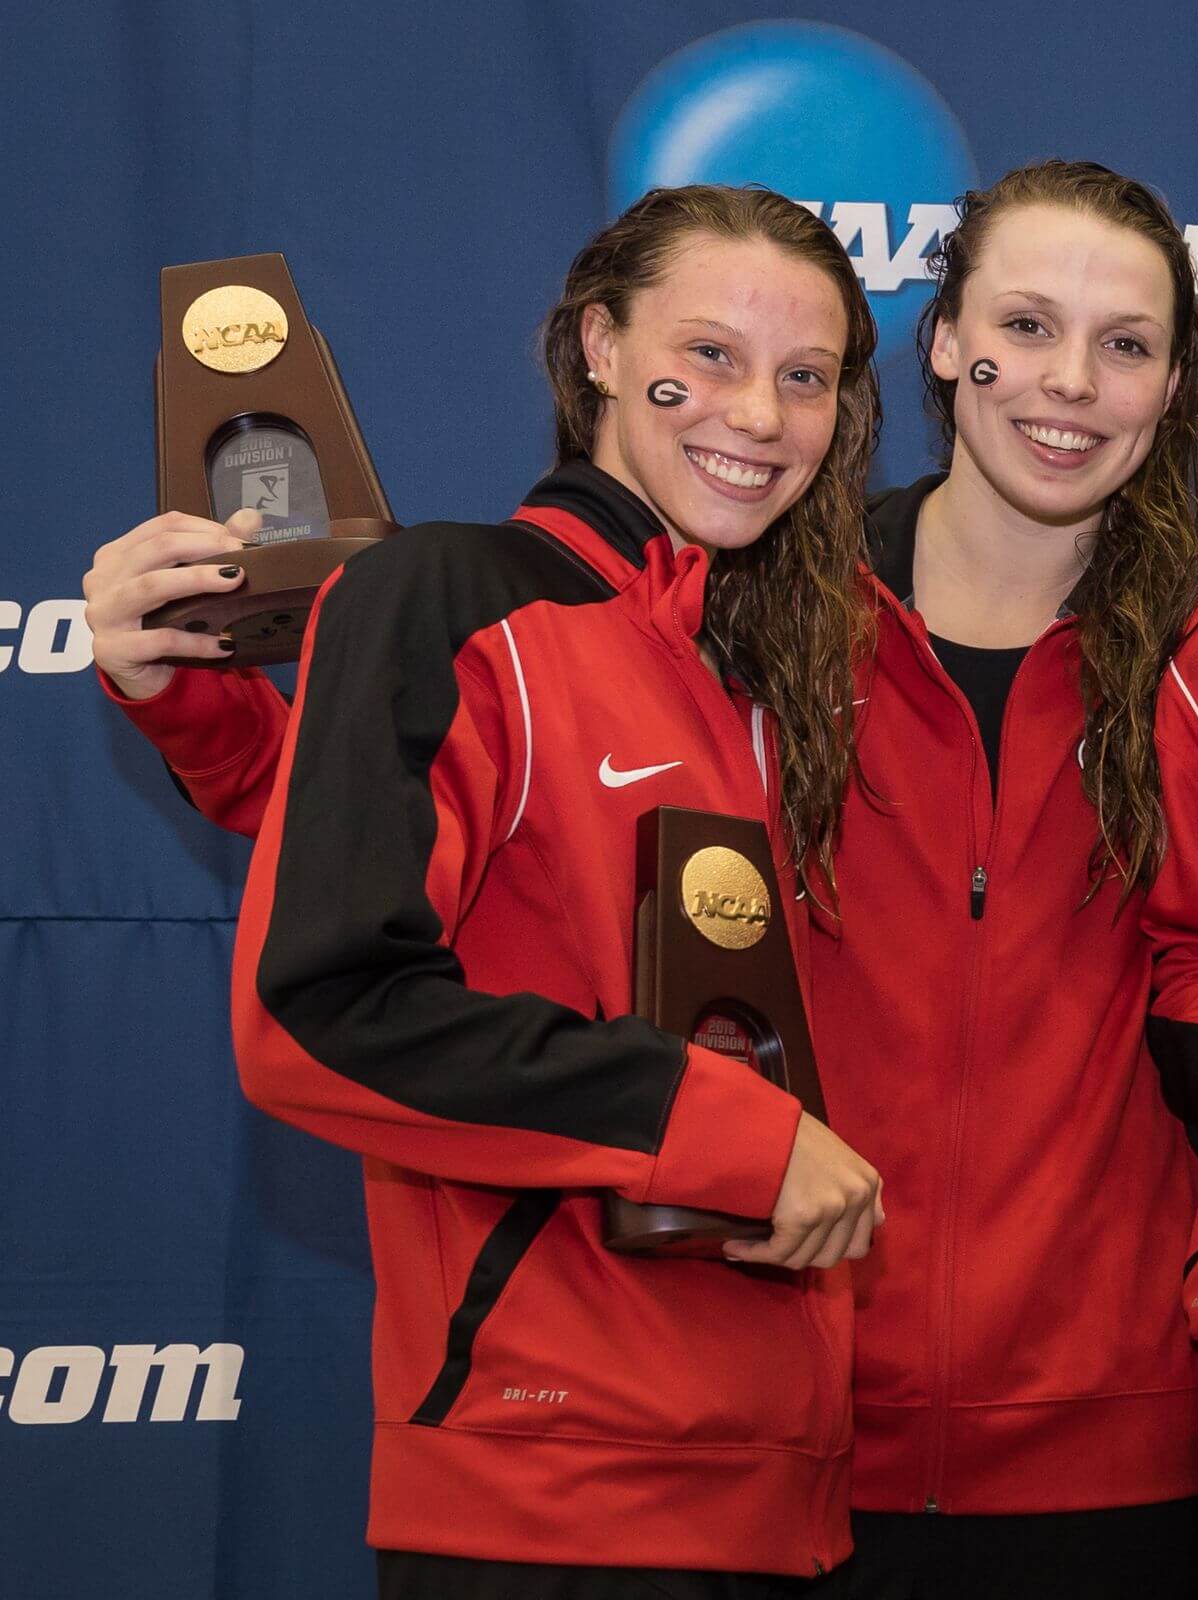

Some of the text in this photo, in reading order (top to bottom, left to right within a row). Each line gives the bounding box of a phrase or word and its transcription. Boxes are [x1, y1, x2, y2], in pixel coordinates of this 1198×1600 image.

[193, 321, 285, 354] NCAA
[225, 447, 284, 468] DIVISION
[252, 525, 311, 542] SWIMMING
[691, 890, 769, 923] NCAA
[708, 1019, 737, 1035] 2016
[0, 1342, 245, 1425] om
[502, 1387, 569, 1404] DRI-FIT
